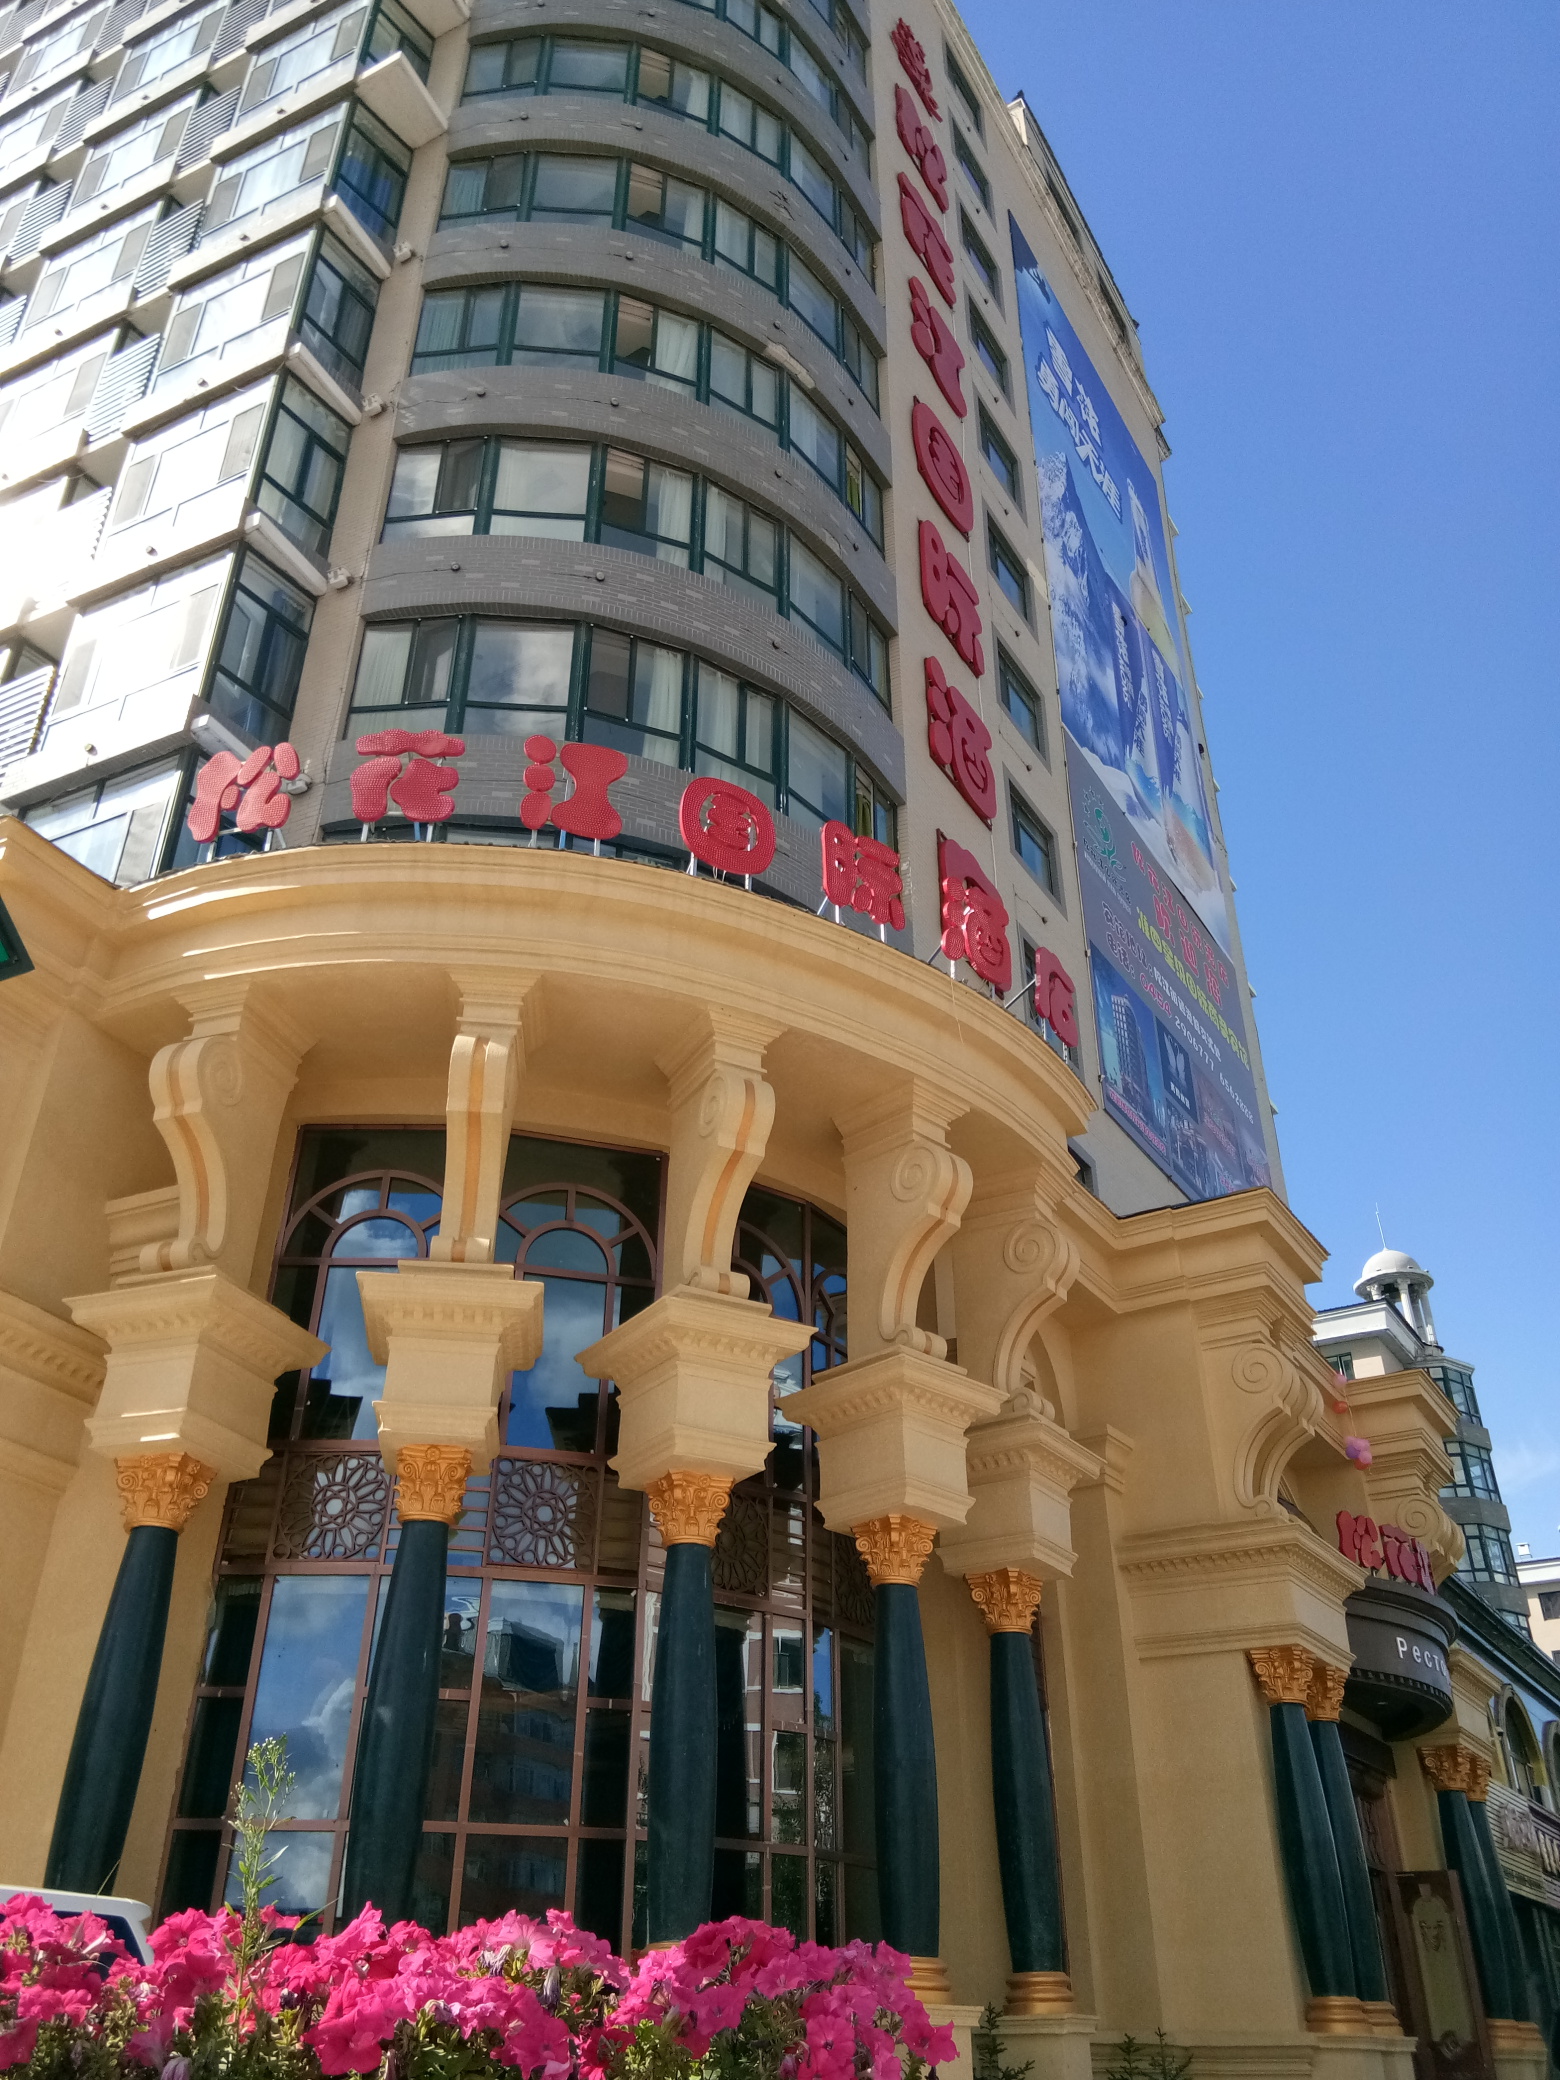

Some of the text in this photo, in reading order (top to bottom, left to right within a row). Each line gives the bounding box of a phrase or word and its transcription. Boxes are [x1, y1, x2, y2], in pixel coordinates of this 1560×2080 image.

[1037, 356, 1122, 519] 勇闯天涯
[1045, 326, 1102, 447] 雪花
[187, 728, 1079, 1048] 松花江国际酒店
[1131, 841, 1229, 988] 松花江国际酒店
[1140, 973, 1172, 1018] 0454
[1174, 1015, 1215, 1072] 2906777
